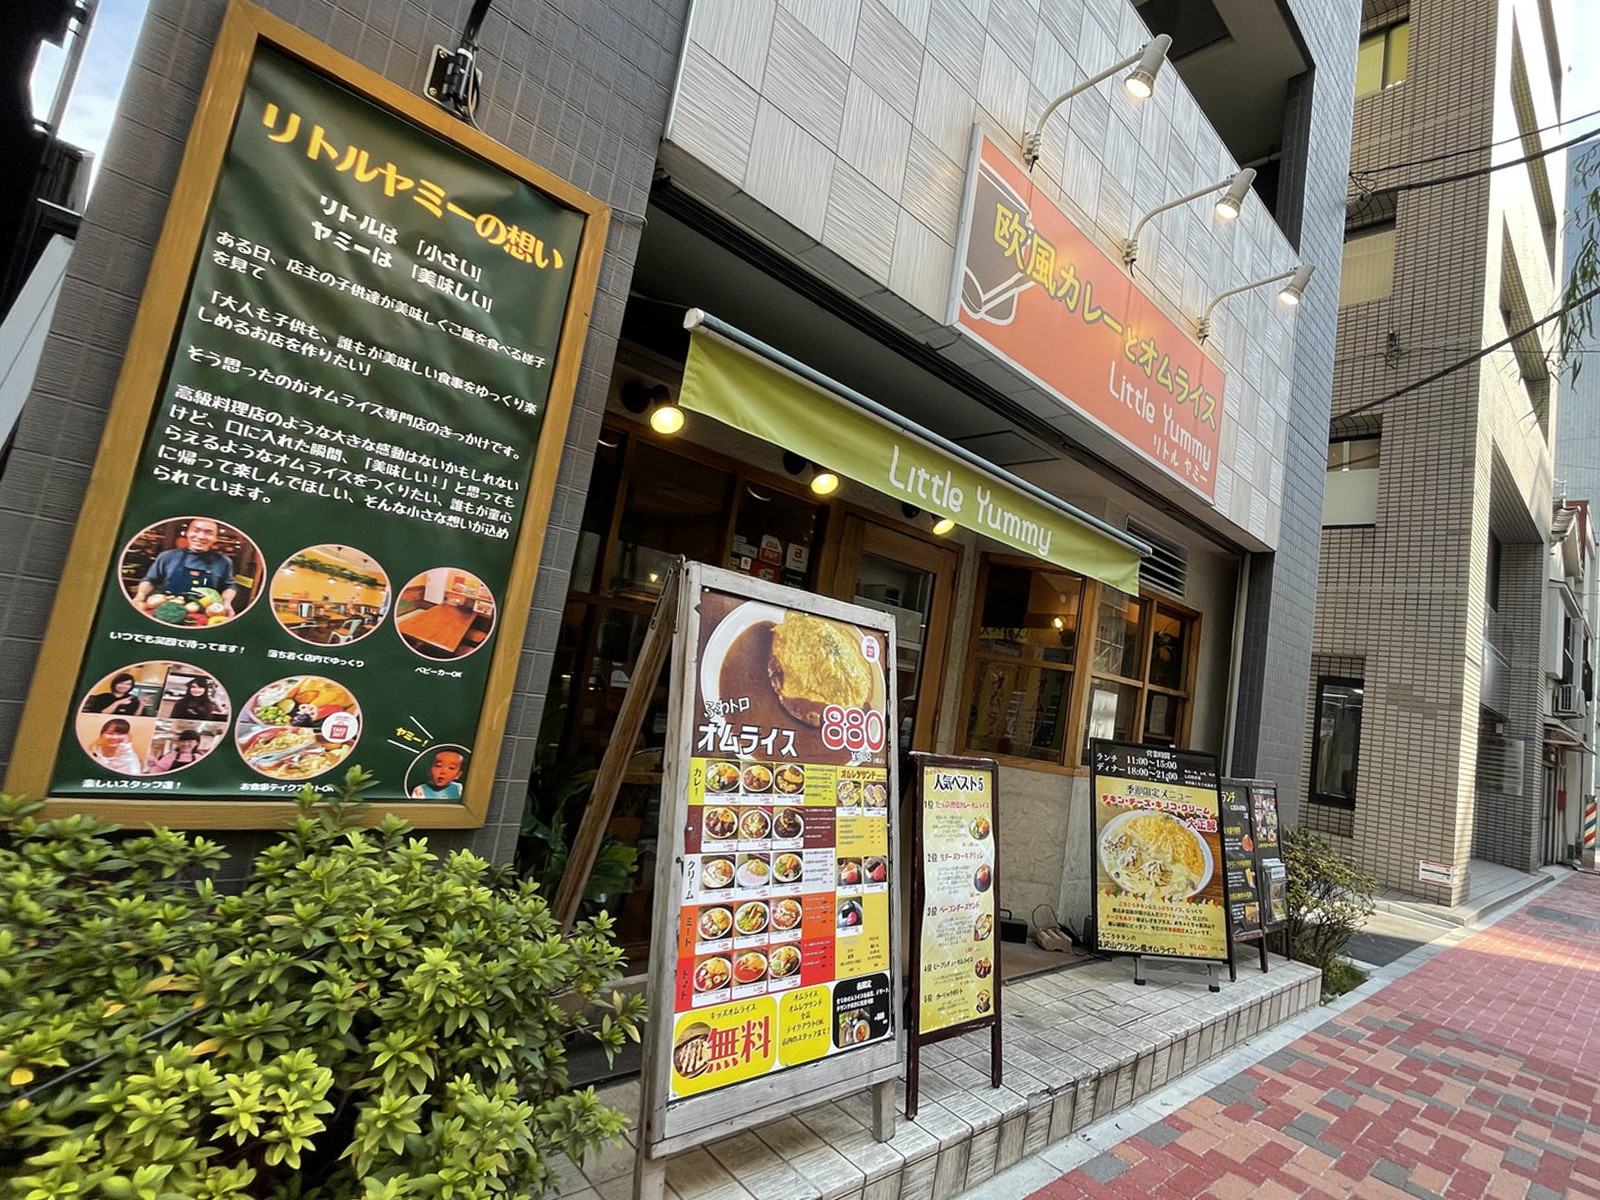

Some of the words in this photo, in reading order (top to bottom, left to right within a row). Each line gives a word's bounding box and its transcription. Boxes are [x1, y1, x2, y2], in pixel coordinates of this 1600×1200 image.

[262, 102, 565, 268] リトルヤミーの想い
[320, 195, 398, 245] リトルは
[212, 250, 265, 281] を見て
[312, 220, 393, 268] ヤミーは
[994, 203, 1216, 431] 欧風カレーとオムライス
[1110, 361, 1156, 424] Little
[1163, 403, 1212, 468] Yummy
[1152, 435, 1179, 467] リトル
[152, 465, 272, 505] られています。
[888, 444, 964, 514] Little
[976, 485, 1053, 557] Yummy
[698, 723, 799, 757] オムライス
[822, 705, 886, 752] 880
[693, 767, 702, 796] カレー
[686, 860, 695, 901] クリーム
[684, 918, 692, 947] ミート
[707, 1016, 772, 1074] 無料
